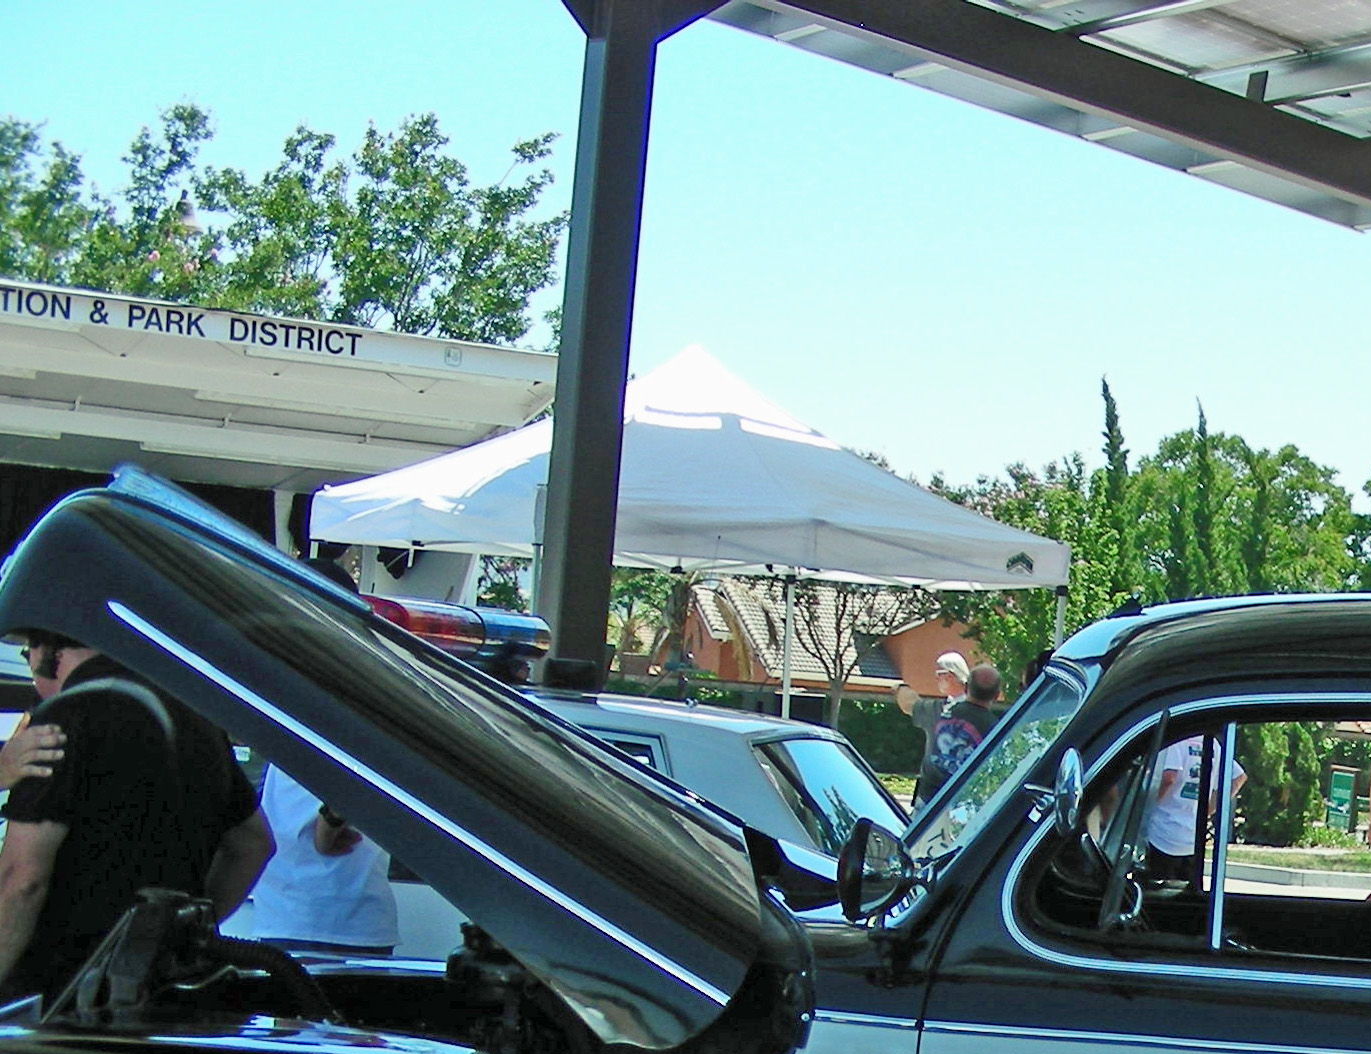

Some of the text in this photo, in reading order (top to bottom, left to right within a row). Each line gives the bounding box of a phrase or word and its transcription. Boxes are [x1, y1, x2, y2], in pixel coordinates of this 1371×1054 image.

[0, 287, 363, 356] TION & PARK DISTRICT
